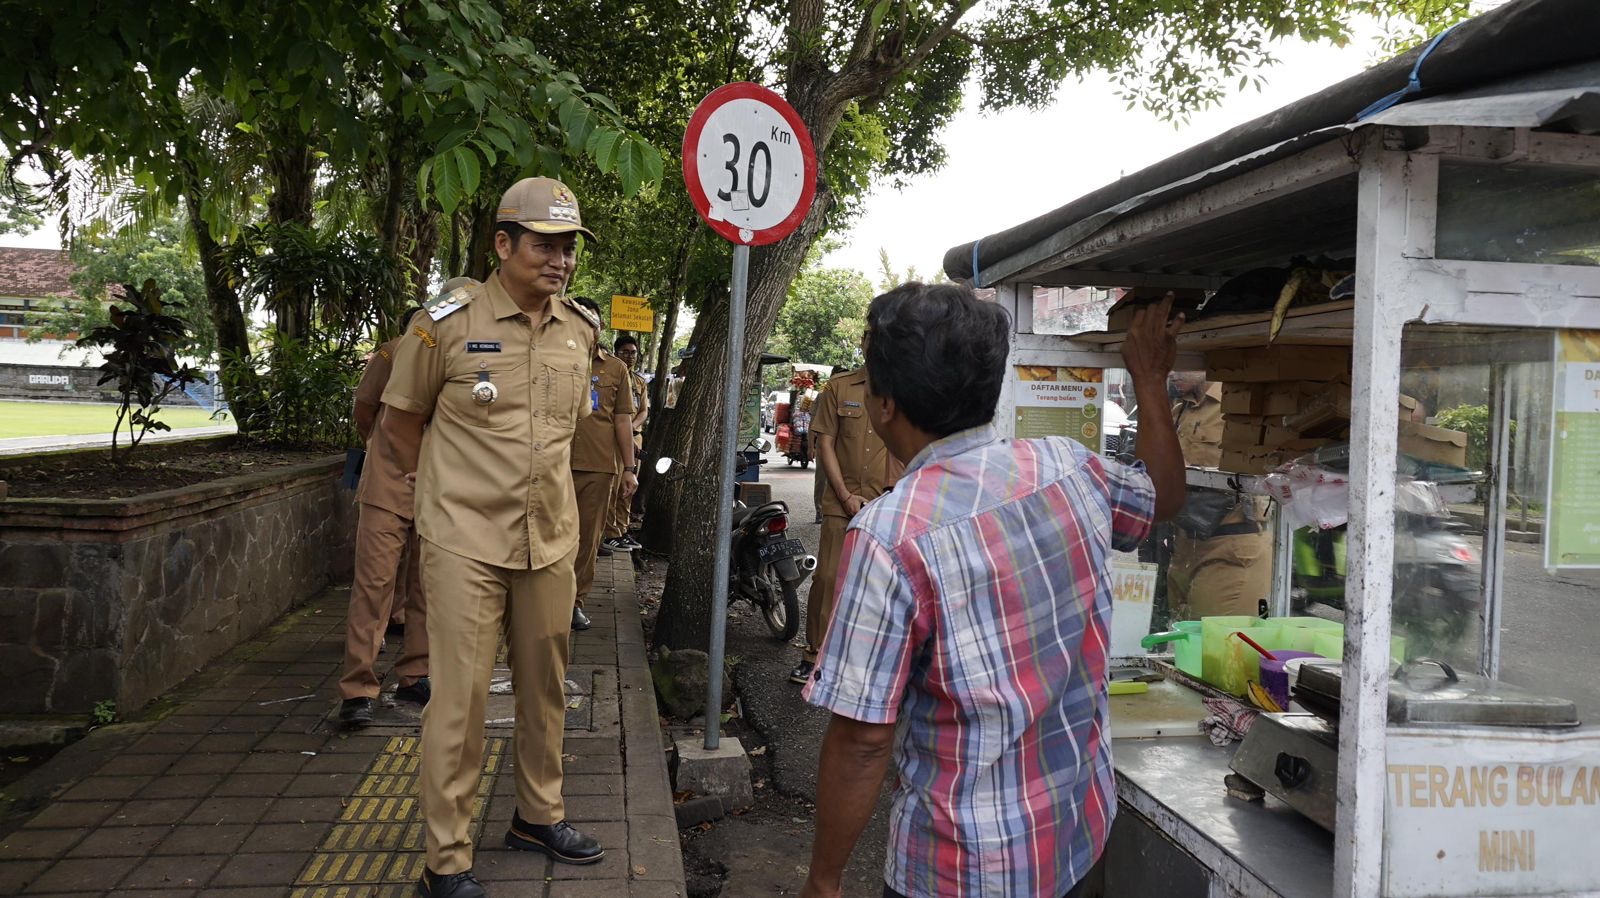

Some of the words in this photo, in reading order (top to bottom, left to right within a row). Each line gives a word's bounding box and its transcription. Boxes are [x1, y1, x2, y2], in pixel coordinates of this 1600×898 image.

[717, 133, 772, 208] 30
[771, 126, 791, 145] Km
[29, 374, 69, 385] GARUDA
[1388, 764, 1509, 808] TERANG
[1478, 830, 1536, 872] MINI
